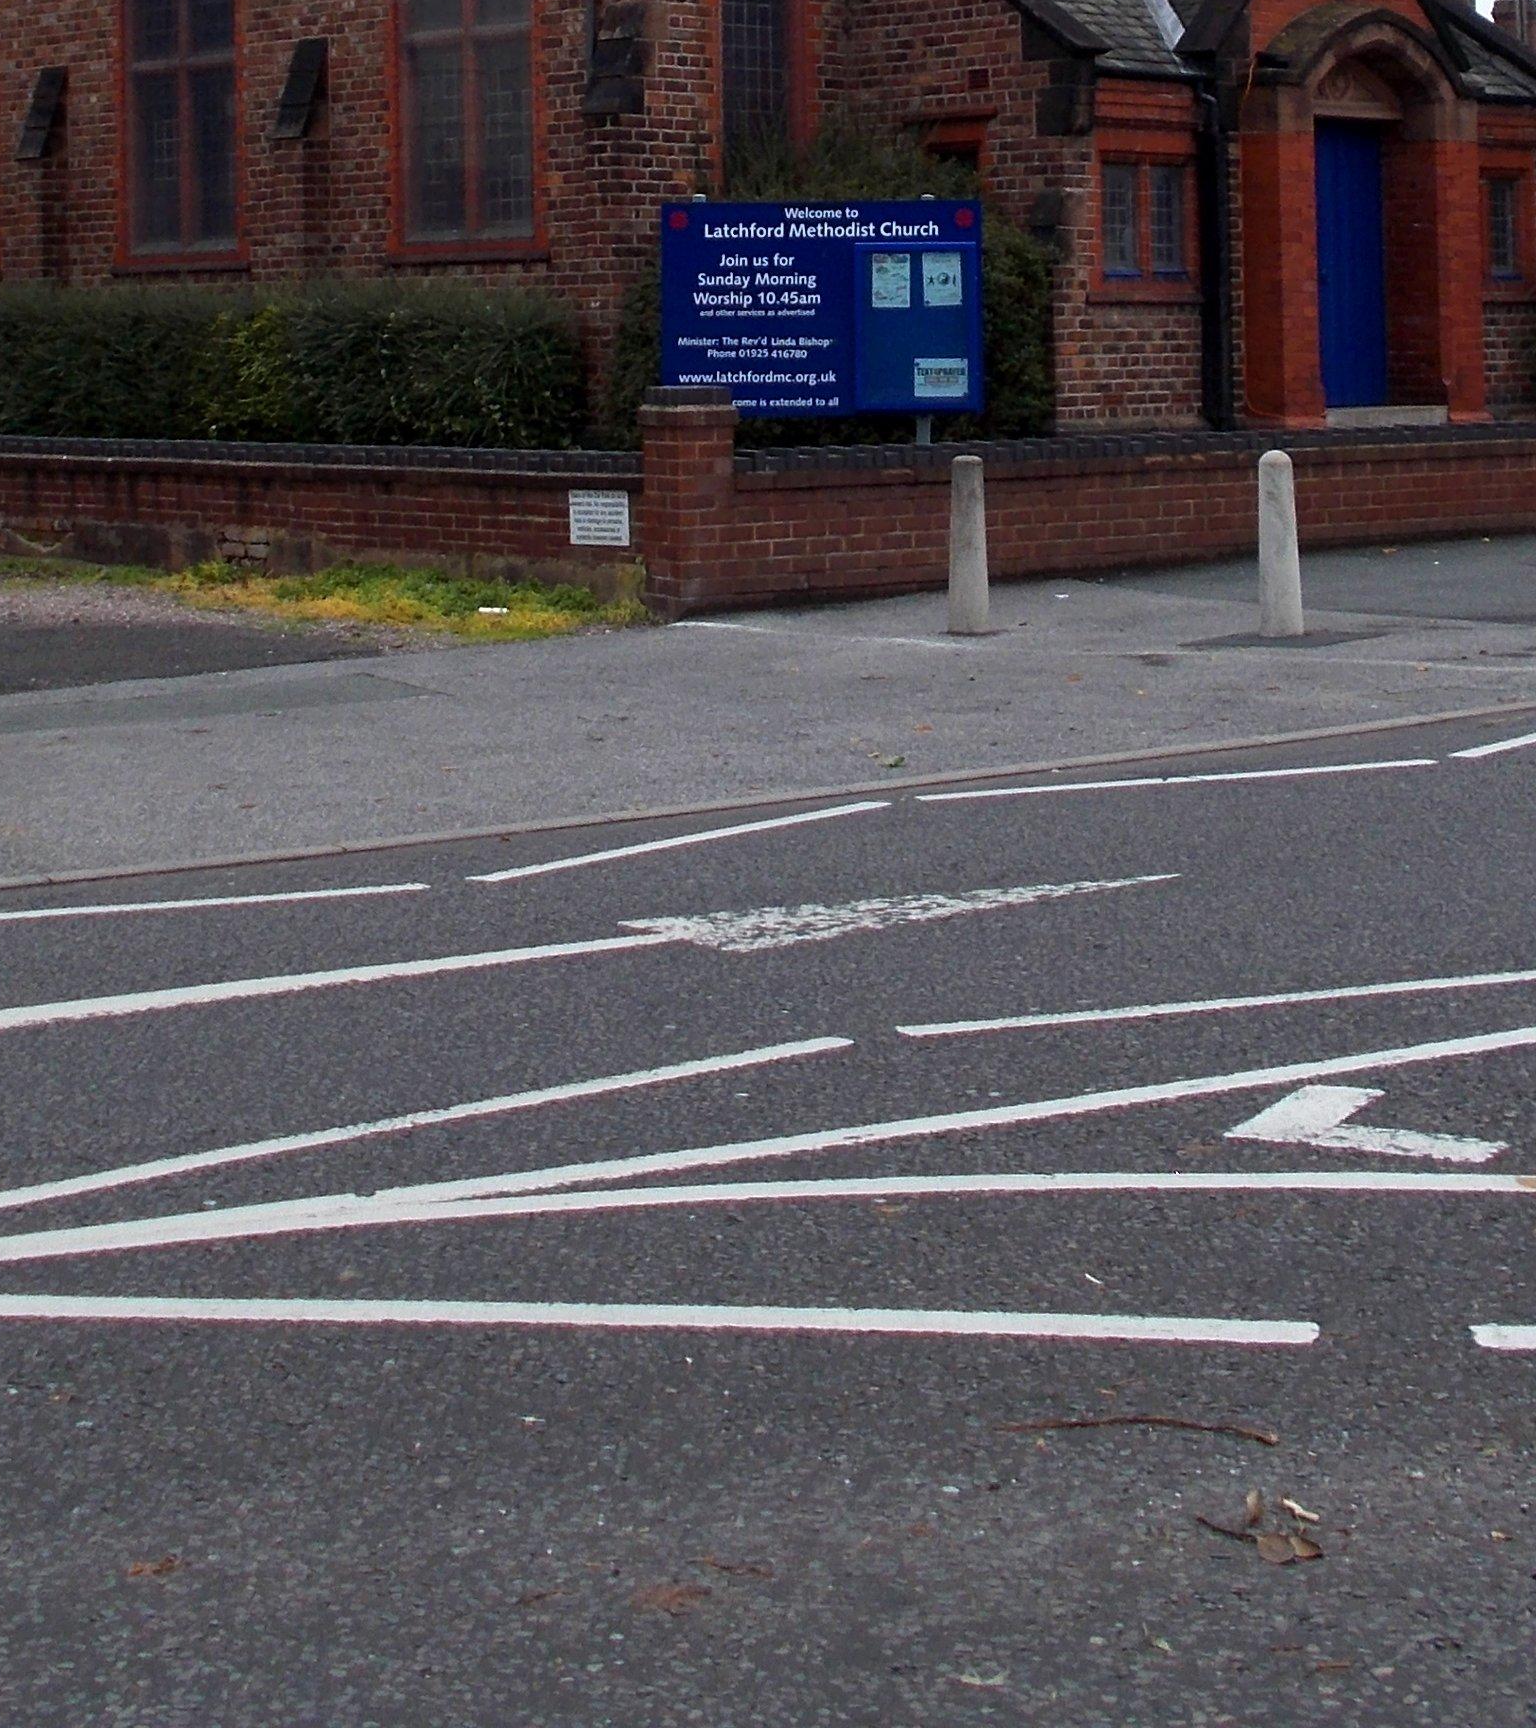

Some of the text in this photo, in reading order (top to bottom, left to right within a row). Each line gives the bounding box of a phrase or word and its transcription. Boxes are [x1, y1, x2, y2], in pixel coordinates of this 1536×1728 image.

[785, 206, 859, 219] Welcome to
[704, 220, 939, 239] Latchford Methodist Church
[719, 252, 795, 267] Join us for
[698, 272, 817, 288] Sunday Morning
[693, 291, 821, 308] Worship 10.45am
[699, 309, 713, 317] and
[716, 309, 735, 317] other
[737, 309, 765, 317] services
[777, 309, 815, 317] advertised
[678, 336, 829, 347] Minister: The Rev'd Linda Bishop
[707, 349, 808, 359] Phone 01925 416780
[678, 370, 836, 386] www.latchfordmc.org.uk
[759, 398, 767, 406] is
[769, 397, 813, 406] extended
[816, 398, 825, 406] to
[828, 397, 839, 406] all
